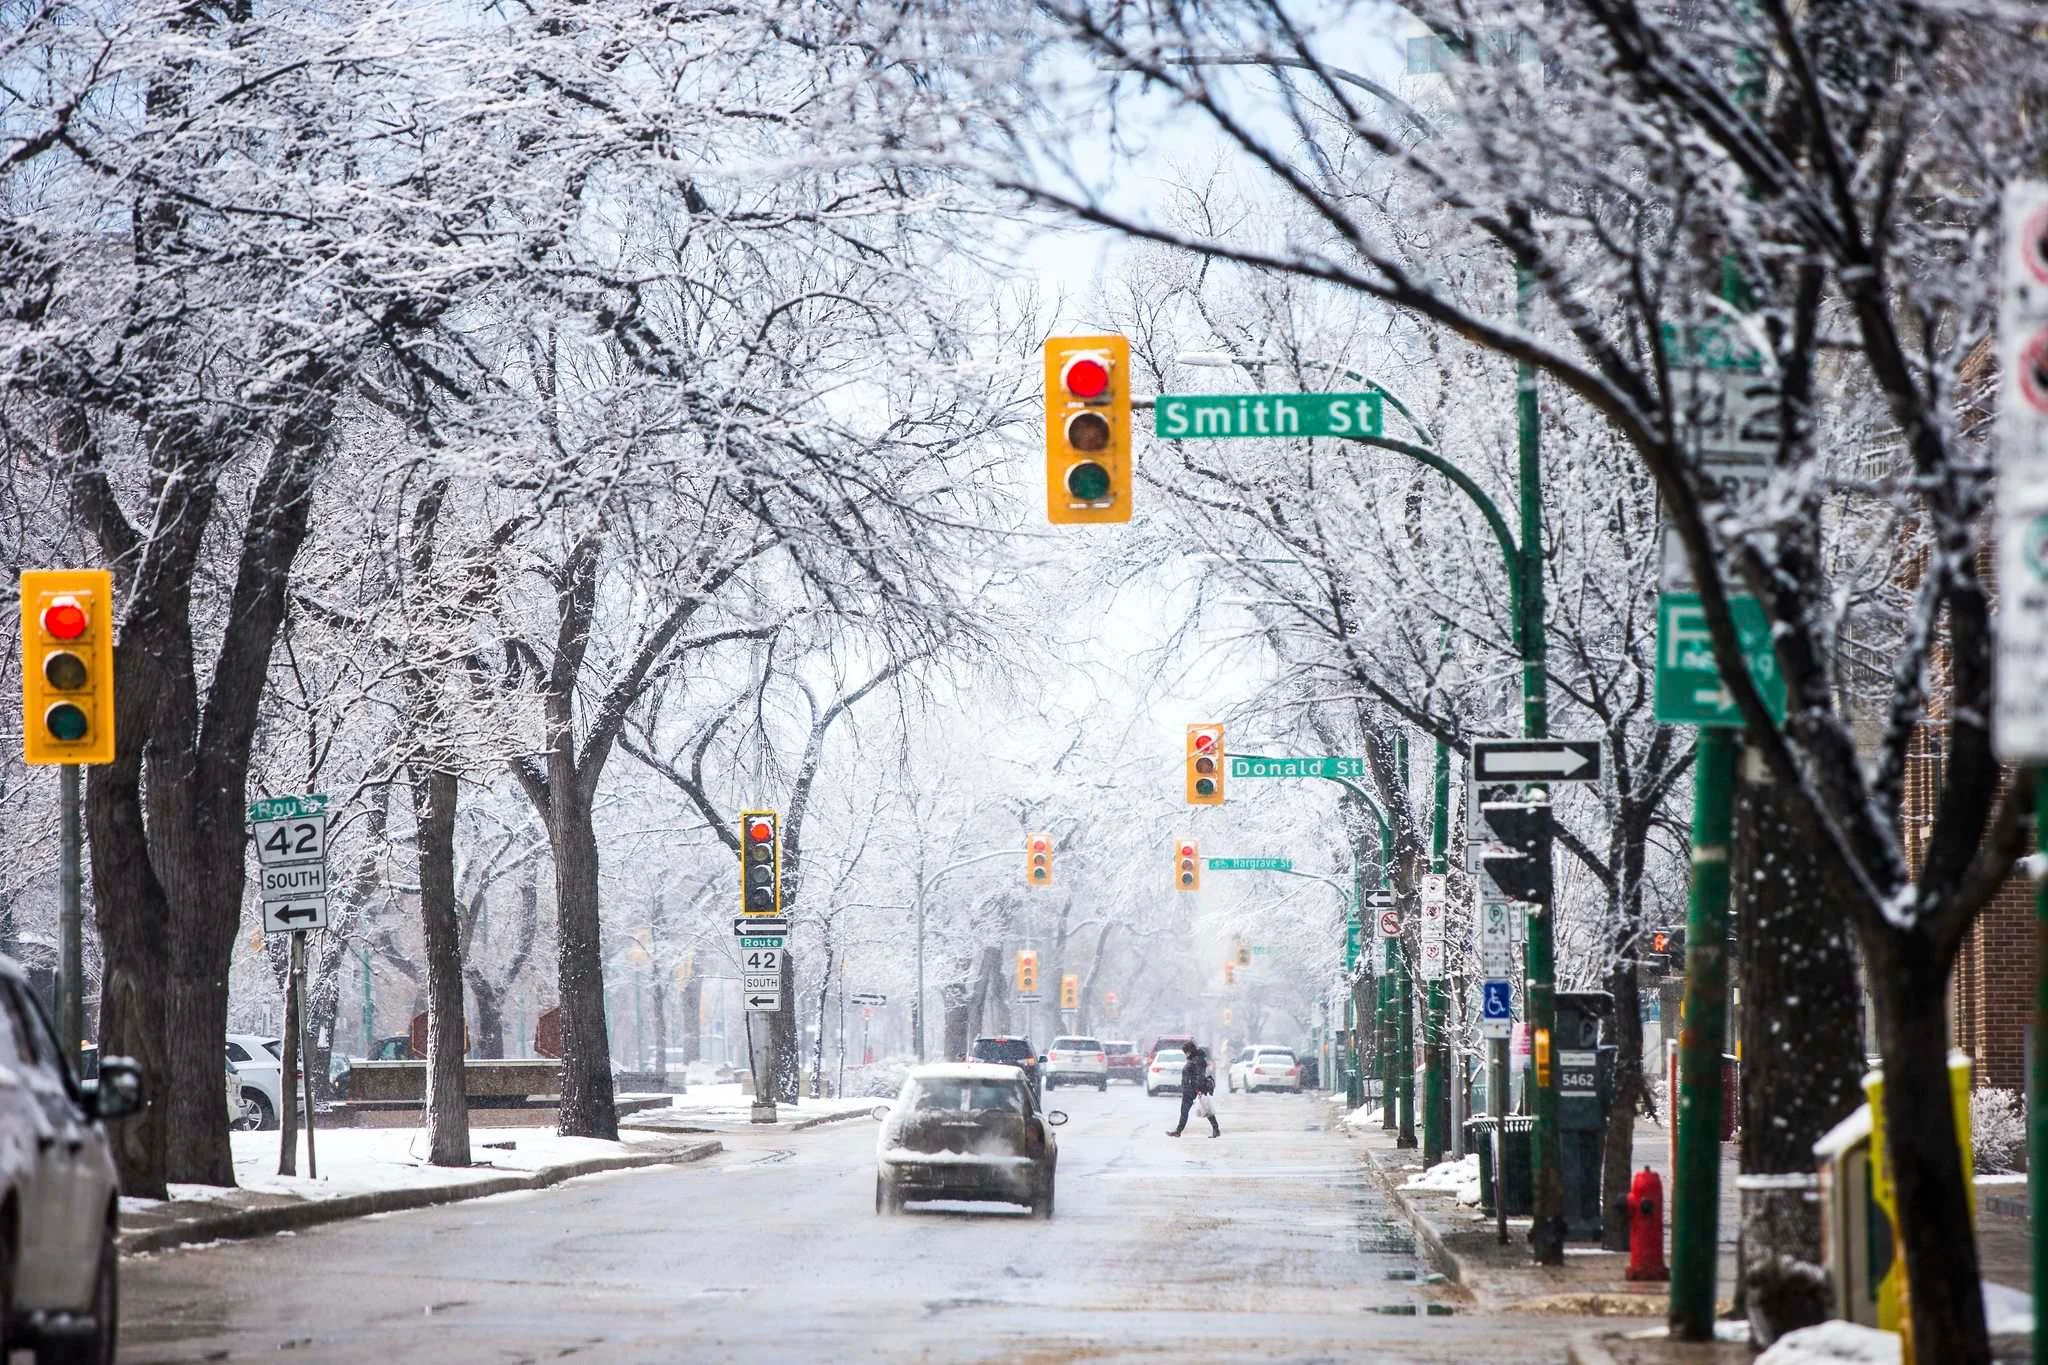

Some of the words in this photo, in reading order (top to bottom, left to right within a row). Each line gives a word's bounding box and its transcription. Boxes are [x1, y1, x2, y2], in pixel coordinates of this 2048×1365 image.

[1166, 399, 1298, 434] Smith
[1327, 400, 1373, 432] St
[1236, 760, 1321, 776] Donald
[1336, 761, 1359, 775] St
[264, 823, 318, 855] 42
[1233, 859, 1277, 870] Hargrave
[1280, 860, 1290, 868] St
[266, 870, 320, 890] SOUTH
[744, 938, 779, 947] Route
[747, 952, 776, 969] 42
[746, 978, 778, 988] SOUTH
[1562, 1073, 1594, 1087] 5462
